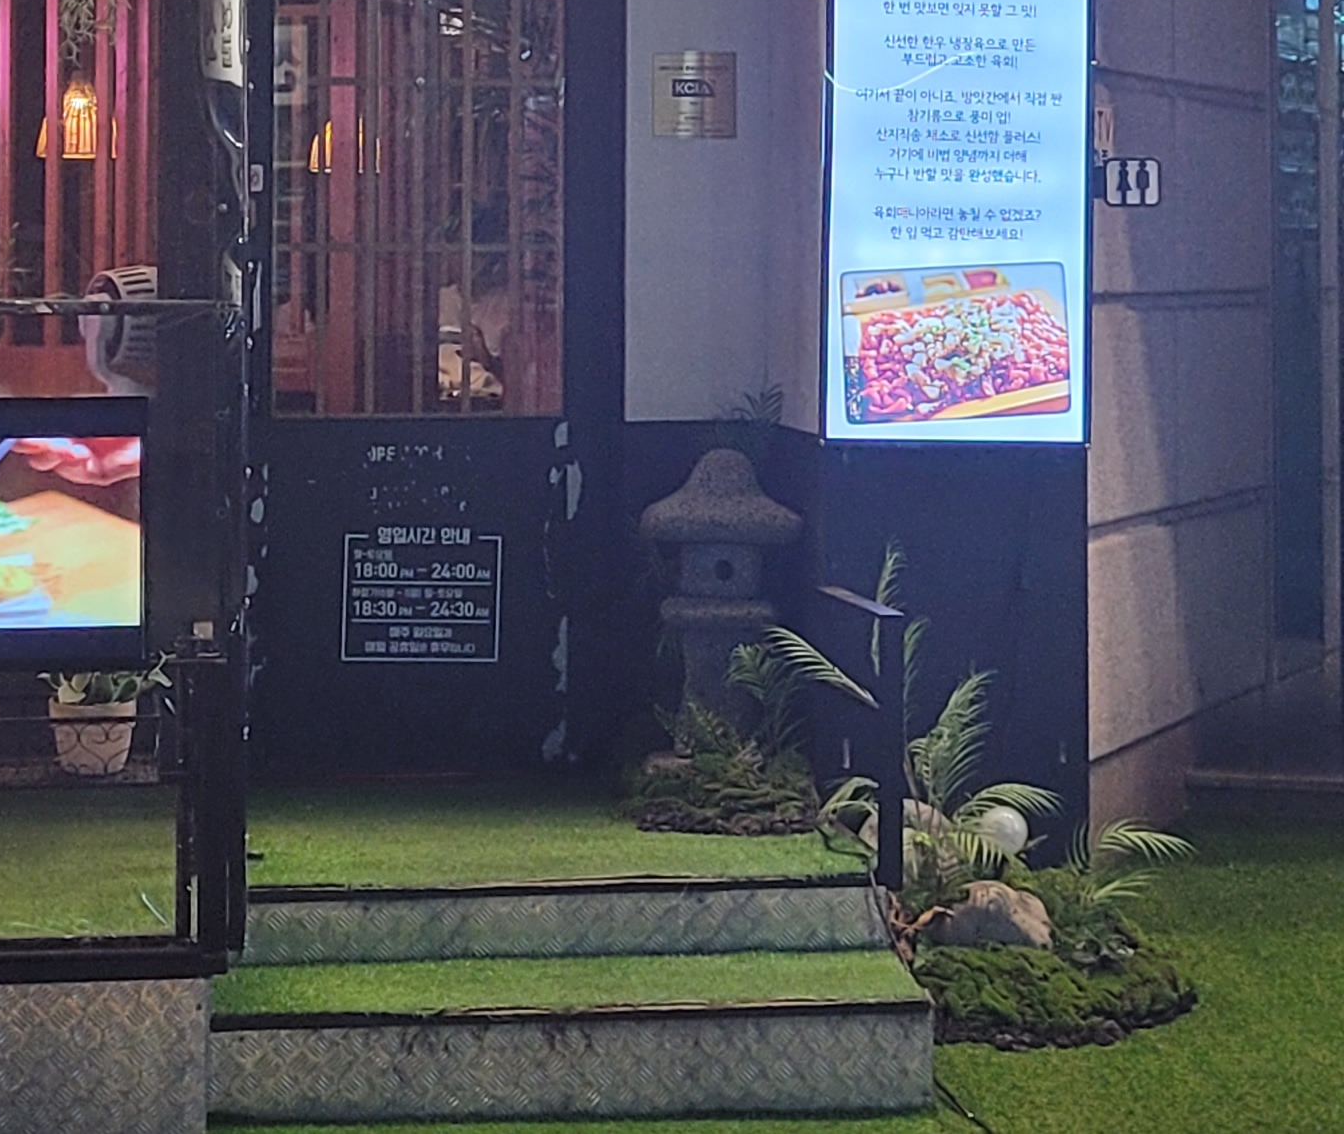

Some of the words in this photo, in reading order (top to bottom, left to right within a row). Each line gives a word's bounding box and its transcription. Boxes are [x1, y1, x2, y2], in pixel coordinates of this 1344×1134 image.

[883, 0, 895, 14] 한
[899, 1, 910, 14] 번
[914, 1, 949, 16] 맛보면
[952, 2, 975, 16] 잊지
[978, 3, 1002, 17] 못할
[1005, 4, 1018, 16] 그
[1021, 4, 1037, 18] 맛!
[884, 34, 918, 49] 신선한
[923, 35, 946, 50] 한우
[949, 36, 1008, 51] 냉장육으로
[1012, 38, 1036, 52] 만든
[902, 52, 948, 66] 부드럽고
[952, 53, 986, 68] 고소한
[991, 54, 1018, 69] 육회!
[676, 81, 711, 94] KCIA
[856, 88, 890, 102] 여기서
[894, 89, 916, 103] 끝이
[962, 90, 1020, 105] 방앗간에서
[1024, 92, 1047, 106] 직접
[907, 108, 965, 123] 참기름으로
[969, 110, 992, 124] 풍미
[996, 111, 1011, 125] 업!
[876, 127, 922, 142] 산지직송
[925, 128, 961, 142] 채소로
[965, 129, 999, 144] 신선함
[1002, 131, 1041, 144] 플러스!
[889, 147, 924, 162] 거기에
[928, 148, 950, 162] 비법
[954, 148, 1000, 163] 양념까지
[1004, 149, 1027, 163] 더해
[874, 167, 909, 181] 누구나
[913, 167, 937, 182] 반할
[941, 168, 965, 182] 맛을
[968, 168, 1042, 183] 완성했습니다.
[957, 207, 980, 221] 놓칠
[985, 208, 997, 221] 수
[999, 207, 1042, 222] 없겠죠?
[890, 225, 902, 239] 한
[906, 226, 917, 240] 입
[921, 226, 944, 240] 먹고
[377, 526, 436, 545] 영업시간
[440, 527, 471, 545] 안내
[354, 562, 398, 578] 18:00
[431, 563, 476, 579] 24:00
[353, 600, 397, 616] 18:30
[430, 601, 474, 617] 24:30
